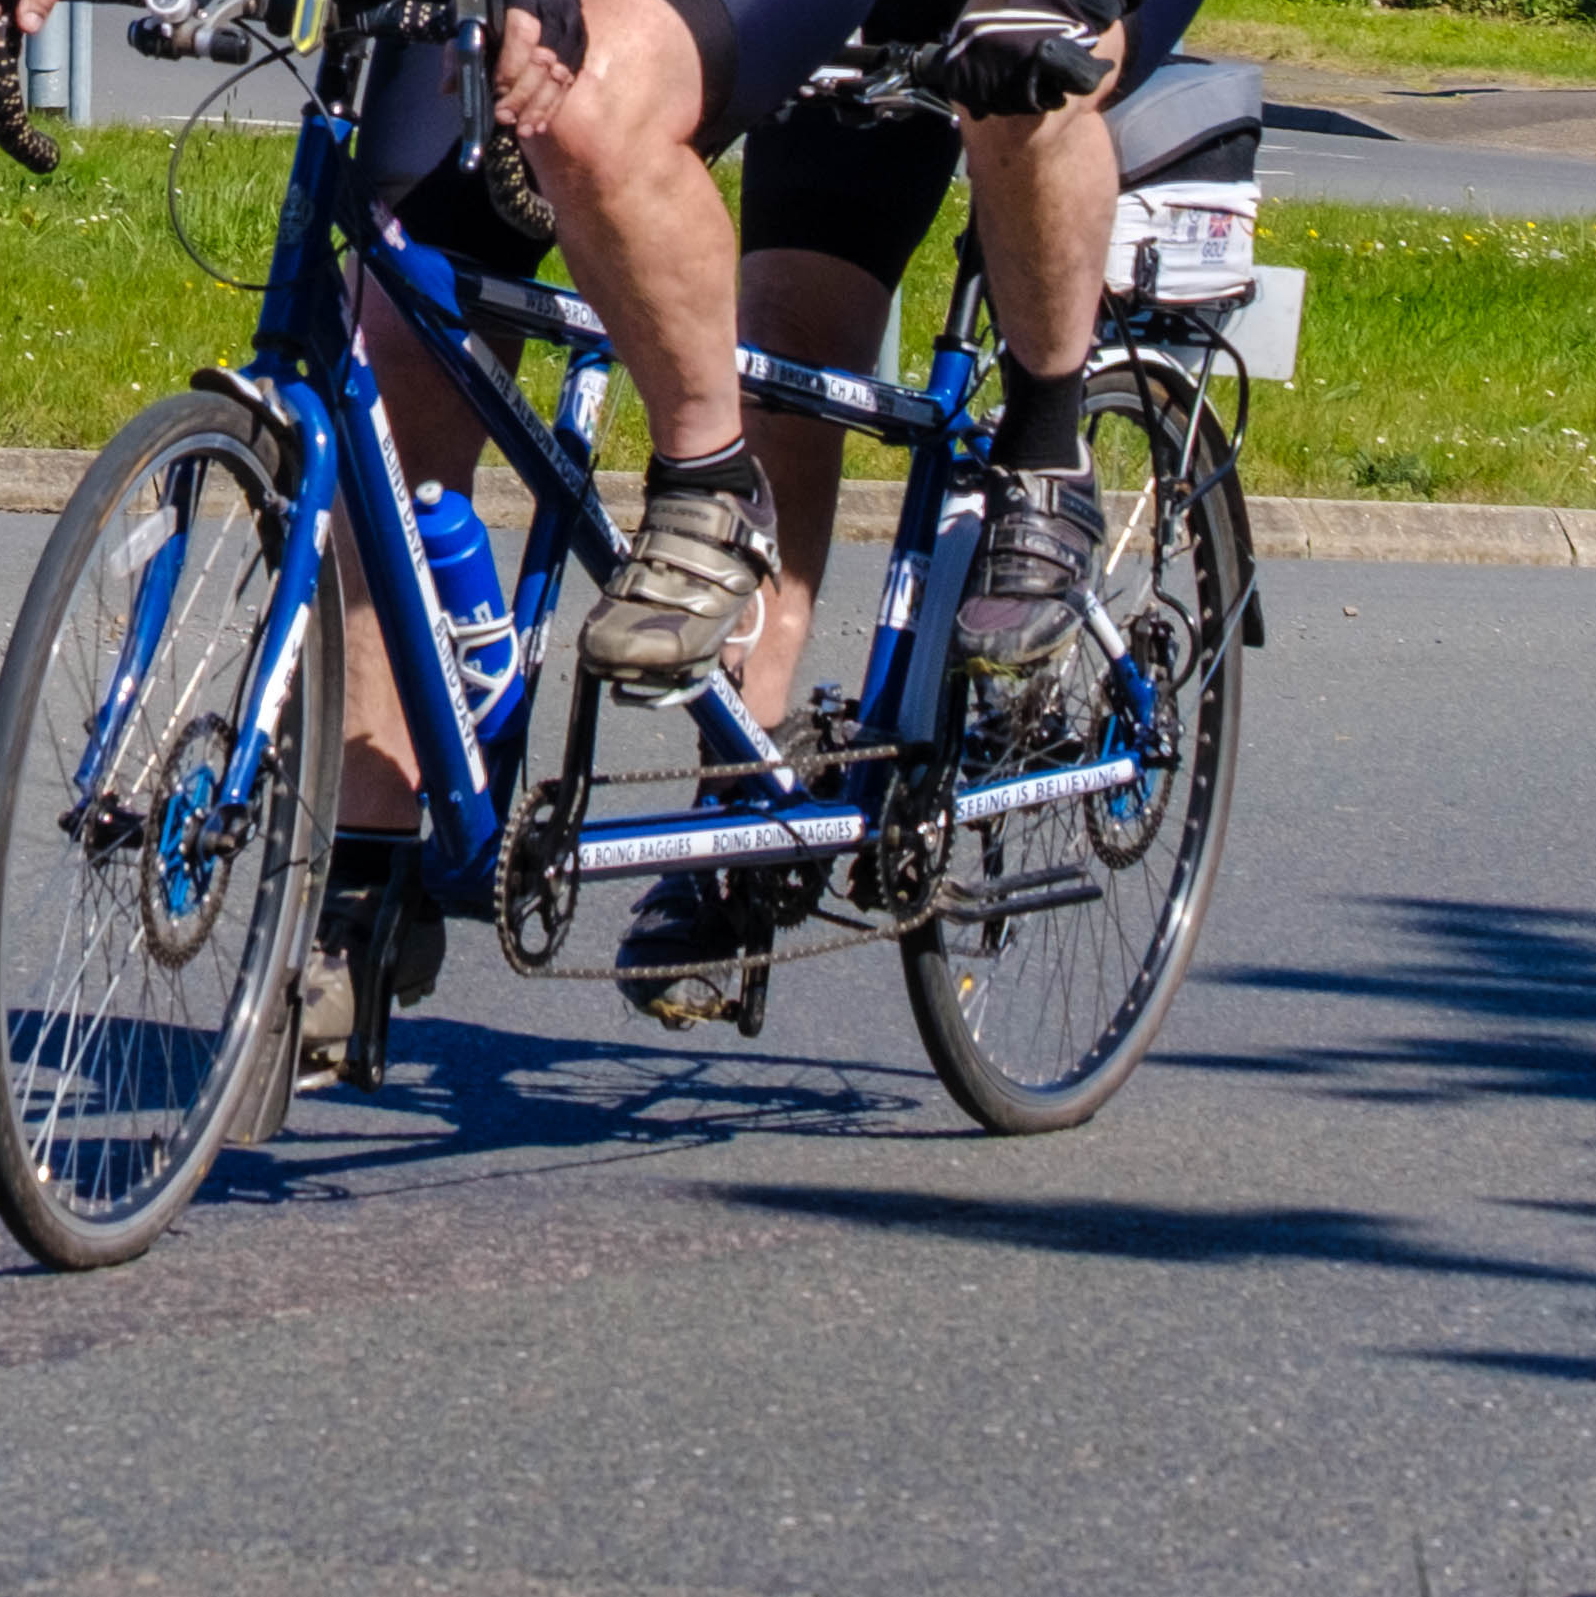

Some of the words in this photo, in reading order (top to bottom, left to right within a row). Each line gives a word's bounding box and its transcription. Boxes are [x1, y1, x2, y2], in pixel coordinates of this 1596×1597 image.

[381, 435, 405, 503] BLIND
[403, 511, 426, 573] DAVE
[434, 617, 459, 688] BLIND
[454, 696, 478, 757] DAVE
[709, 670, 770, 758] OUNDATION
[957, 792, 1011, 818] SEEING
[1016, 785, 1028, 802] IS
[1035, 767, 1119, 798] BELIEVING
[595, 845, 635, 865] BOING
[638, 837, 693, 860] BAGGIES
[712, 831, 752, 853] BOING
